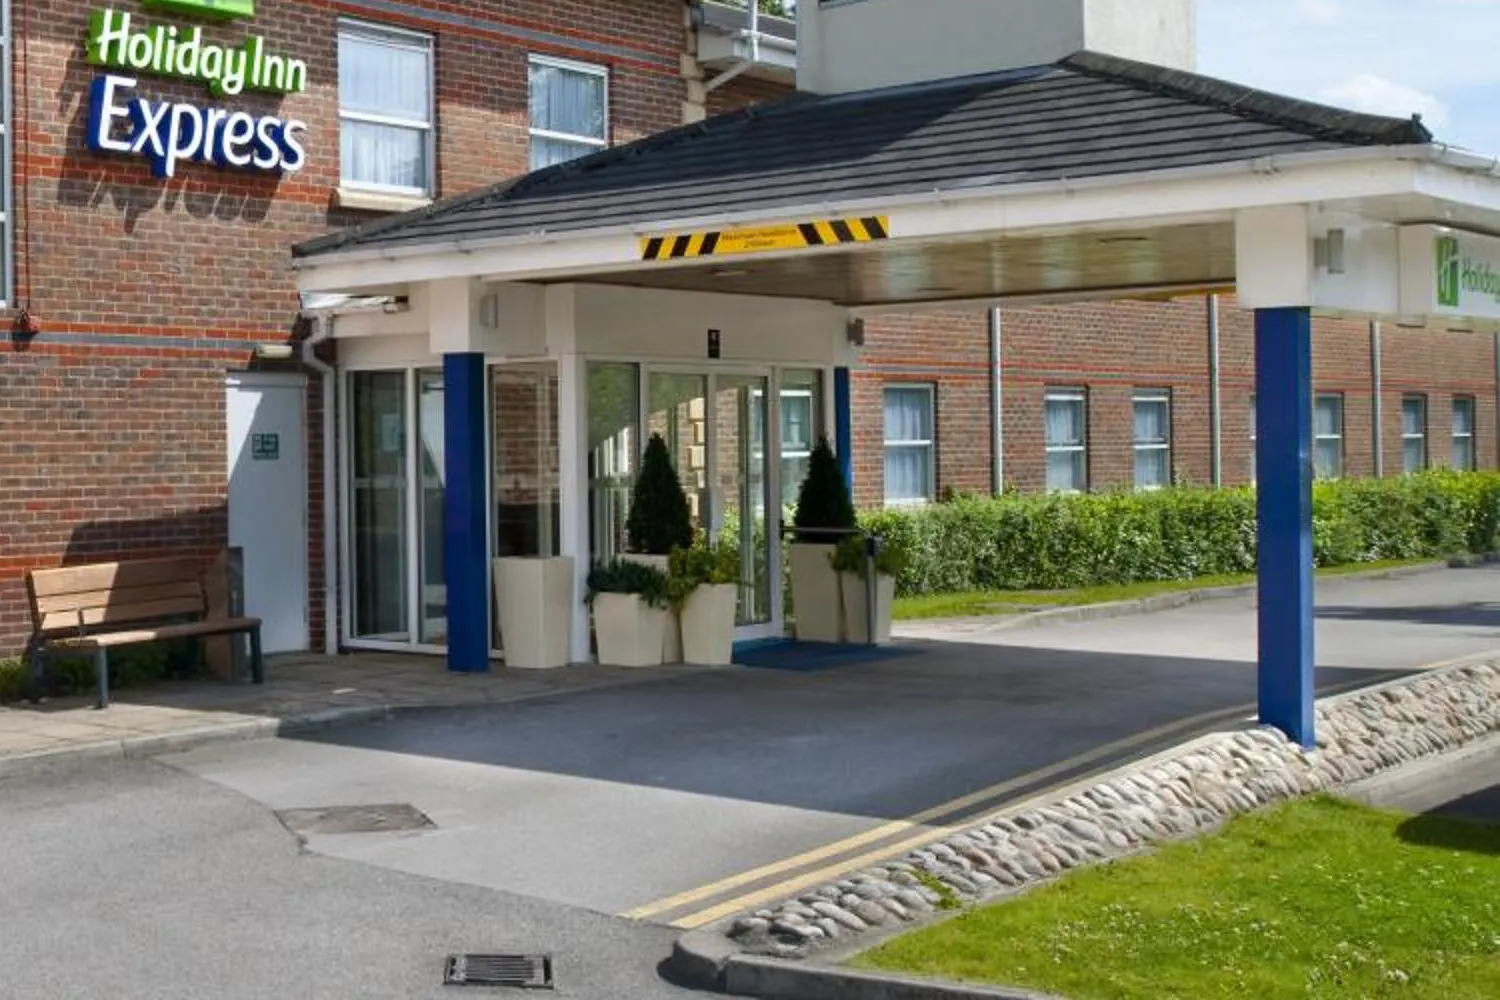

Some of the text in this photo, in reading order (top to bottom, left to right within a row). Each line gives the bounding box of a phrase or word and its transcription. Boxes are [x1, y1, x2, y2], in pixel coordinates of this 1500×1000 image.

[97, 8, 306, 94] Holiday Inn
[98, 74, 307, 177] Express
